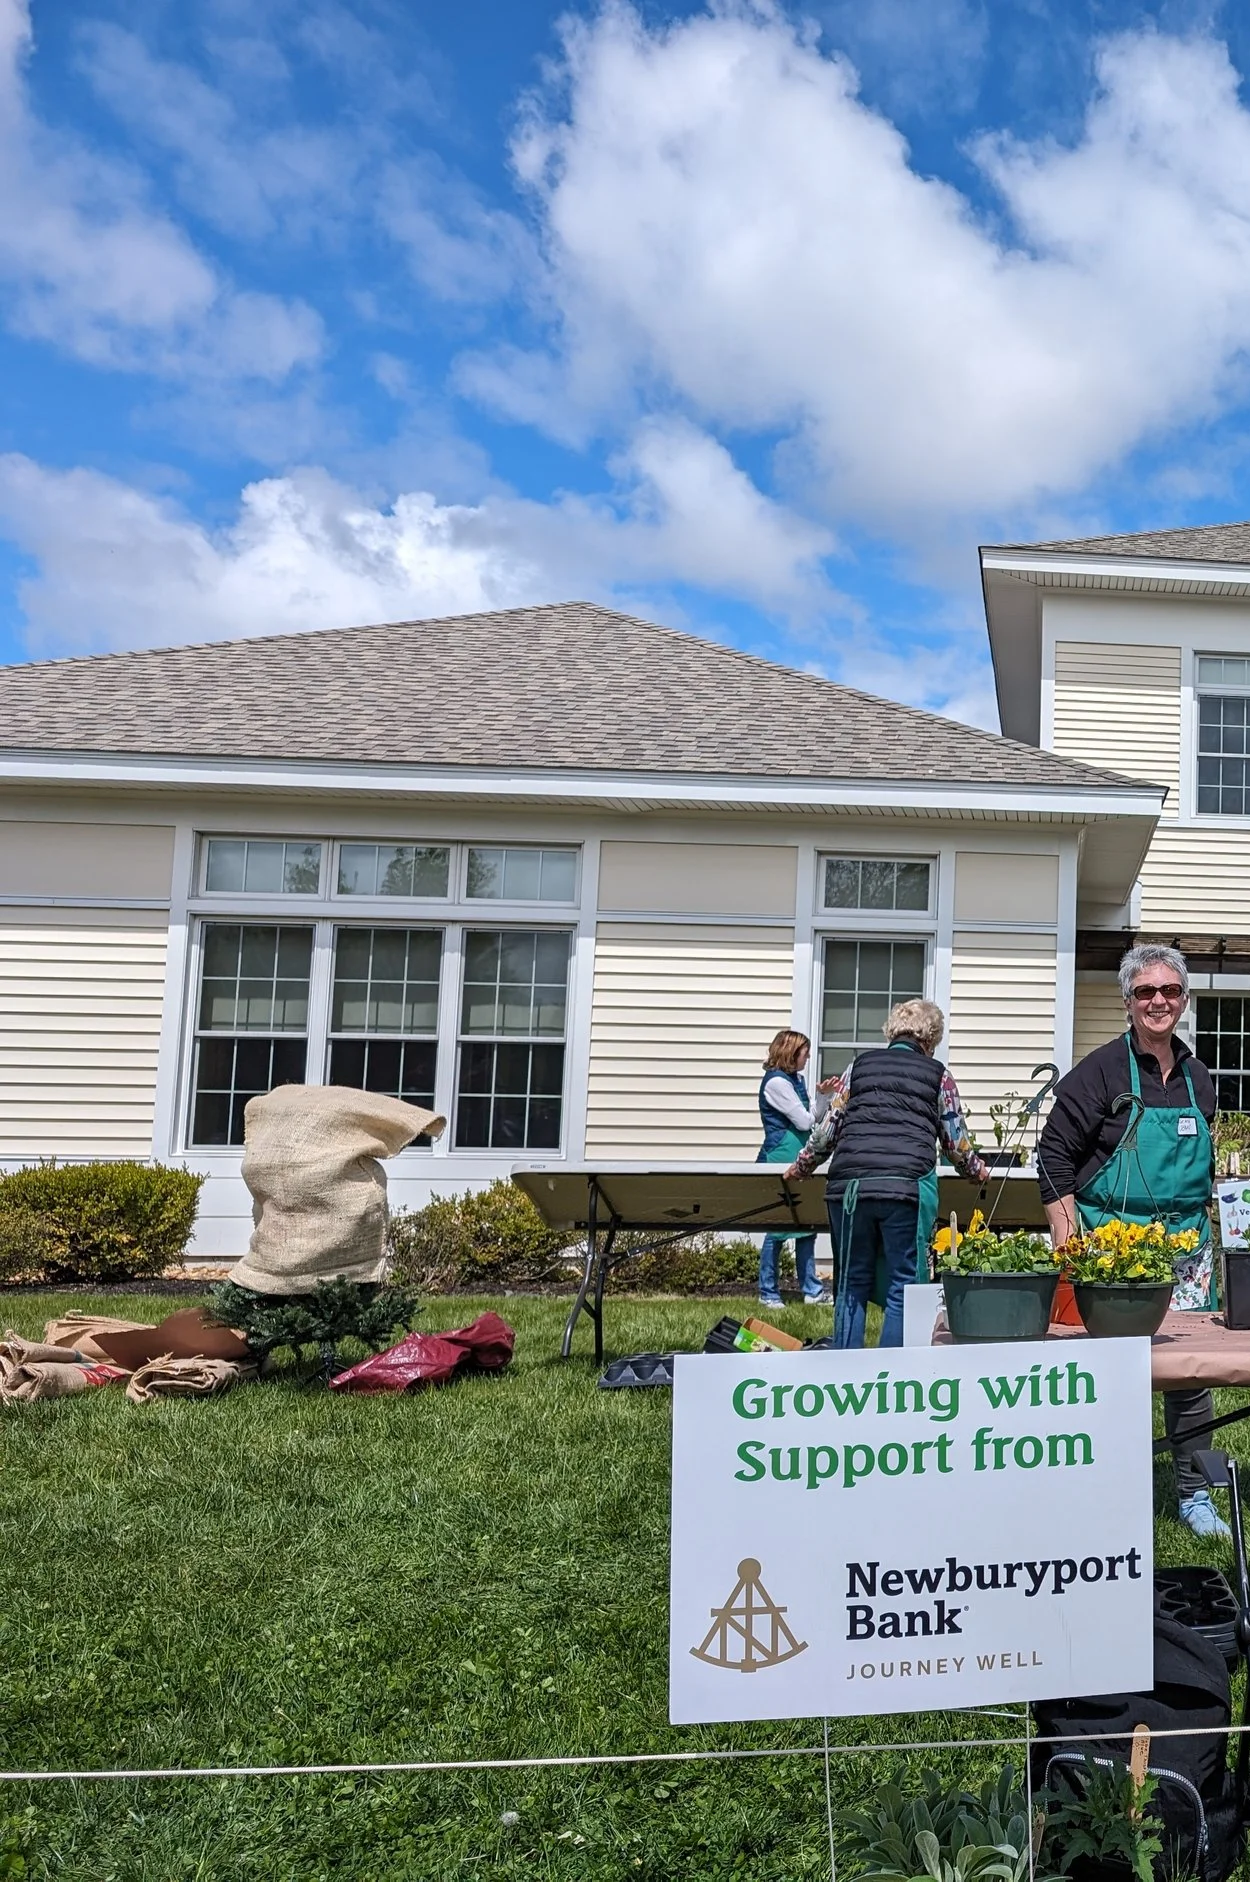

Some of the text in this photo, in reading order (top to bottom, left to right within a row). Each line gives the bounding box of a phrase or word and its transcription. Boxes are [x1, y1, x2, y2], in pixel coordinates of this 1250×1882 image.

[733, 1361, 1098, 1422] Growing with
[733, 1426, 1095, 1490] Support from
[845, 1547, 1142, 1599] Newburyport
[845, 1600, 964, 1641] Bank
[846, 1650, 1044, 1680] JOURNEY WELL
